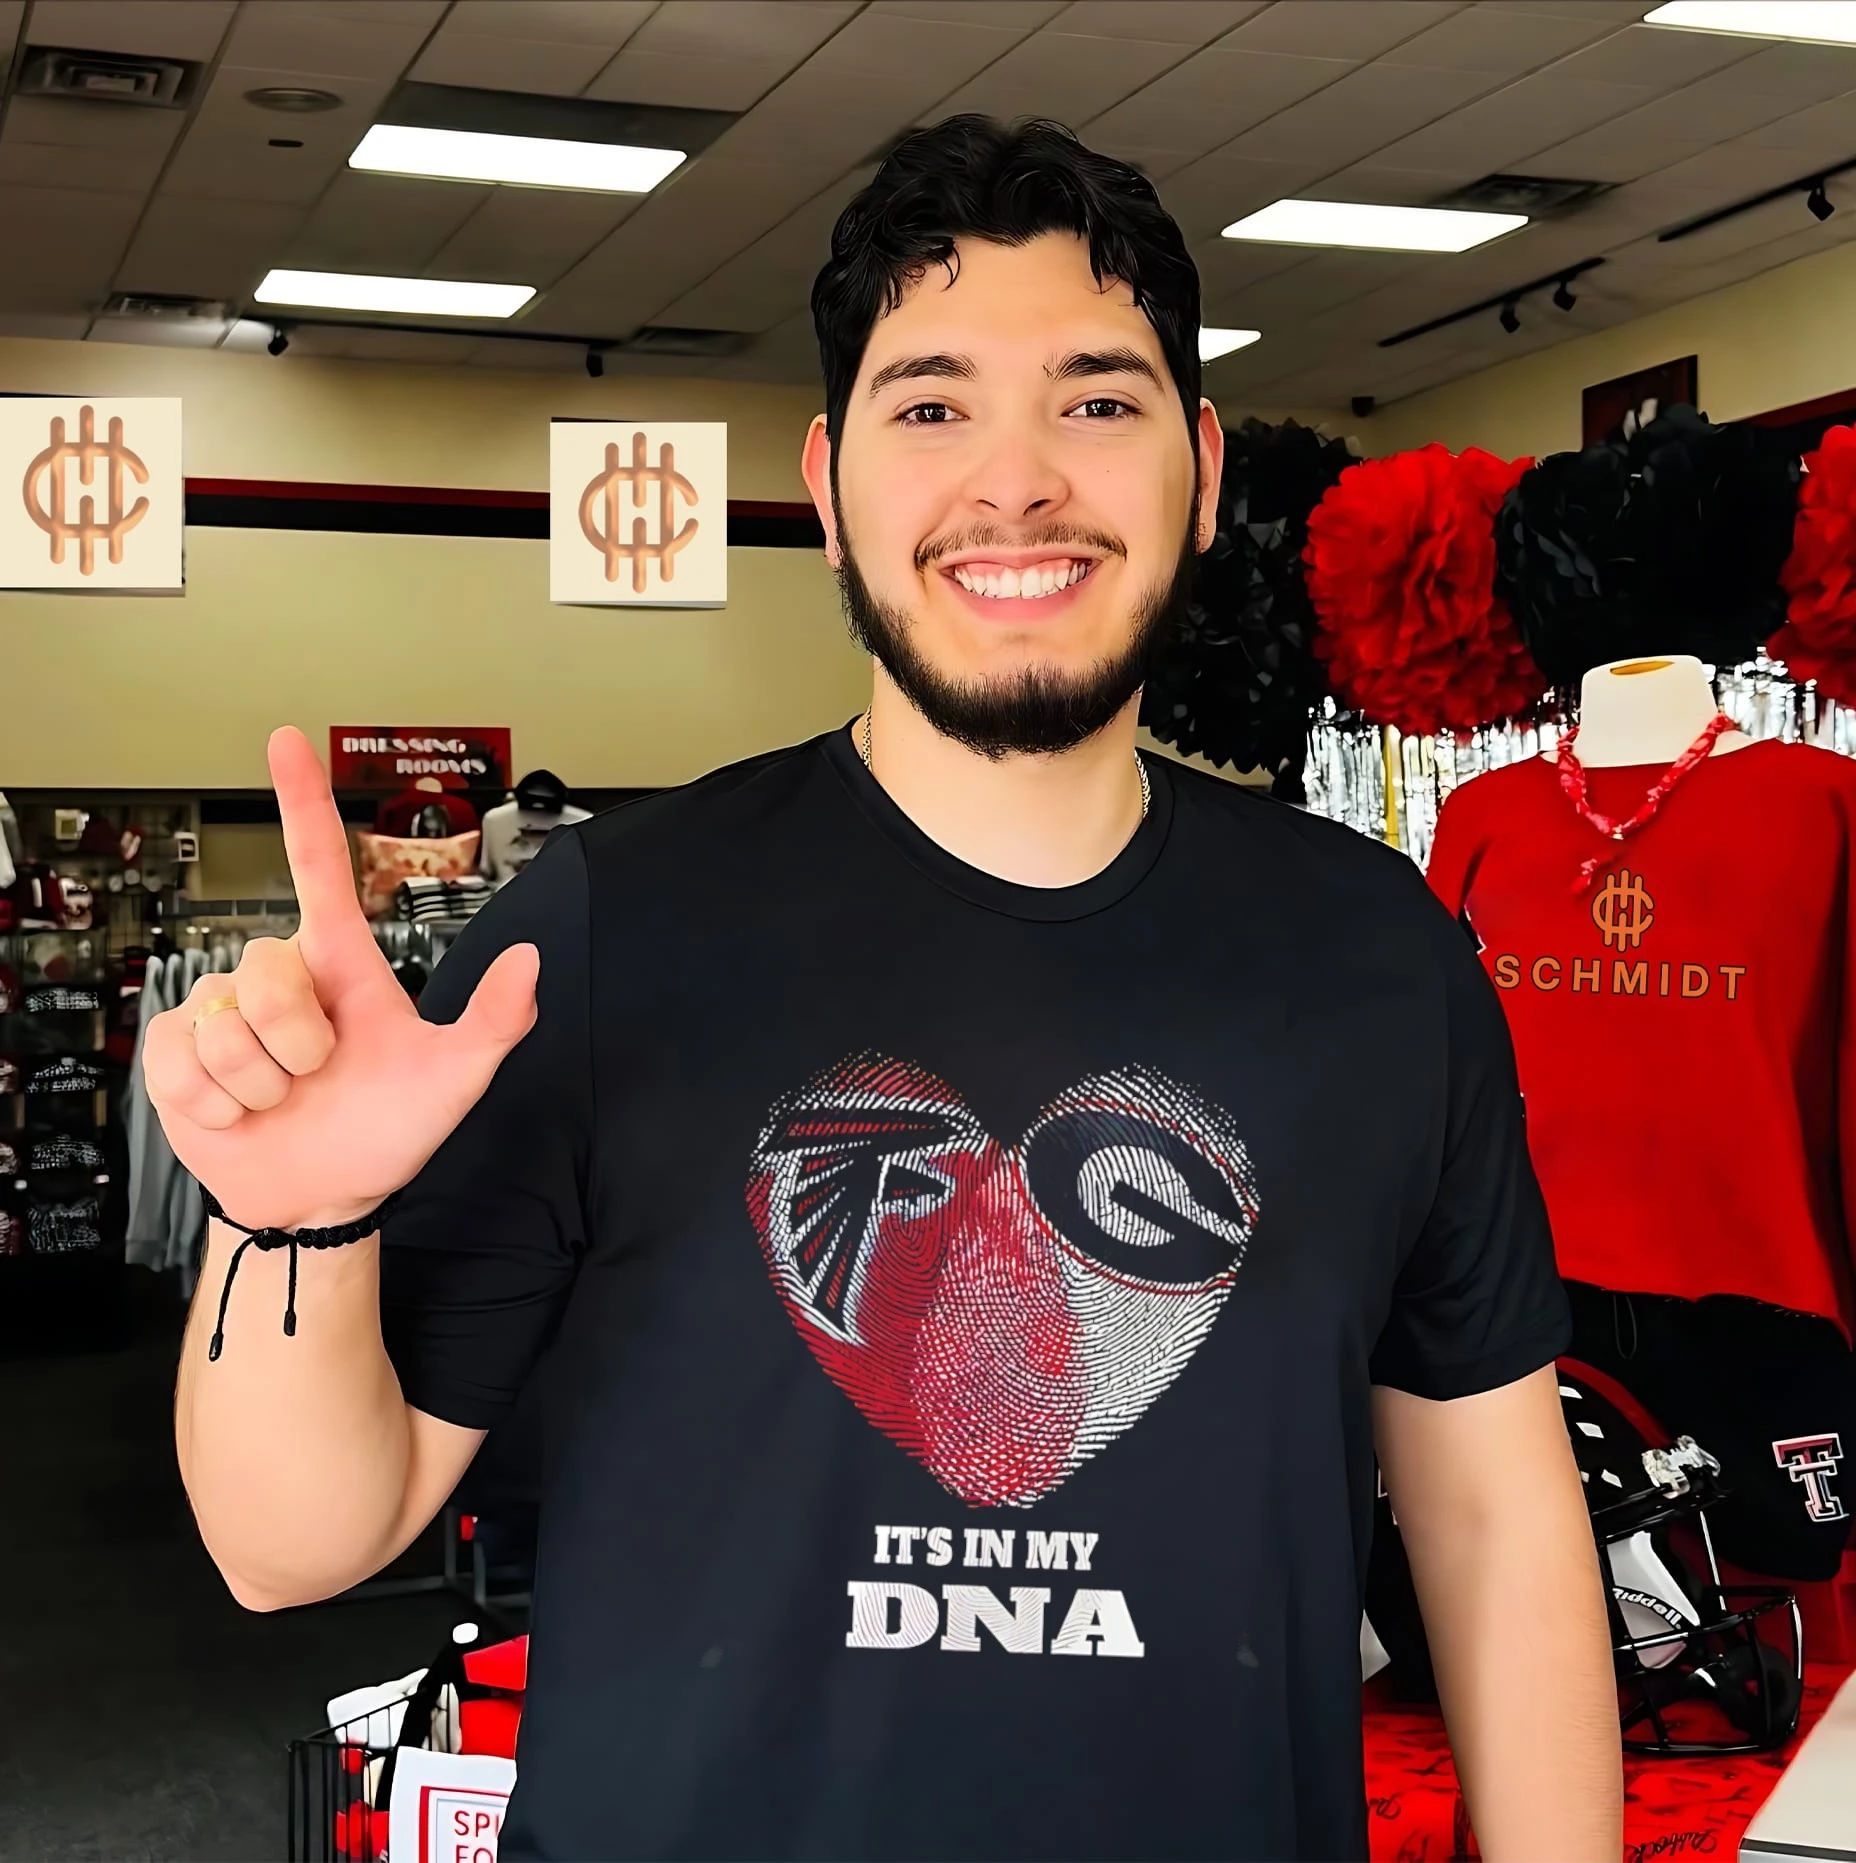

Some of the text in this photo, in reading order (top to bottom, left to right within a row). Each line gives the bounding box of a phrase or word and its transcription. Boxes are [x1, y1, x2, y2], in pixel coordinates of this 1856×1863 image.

[342, 738, 466, 753] DRESSING
[396, 759, 486, 775] ROOMS
[1494, 954, 1746, 1000] SCHMIDT
[874, 1525, 1098, 1571] IT'S IN MY
[846, 1581, 1145, 1657] DNA
